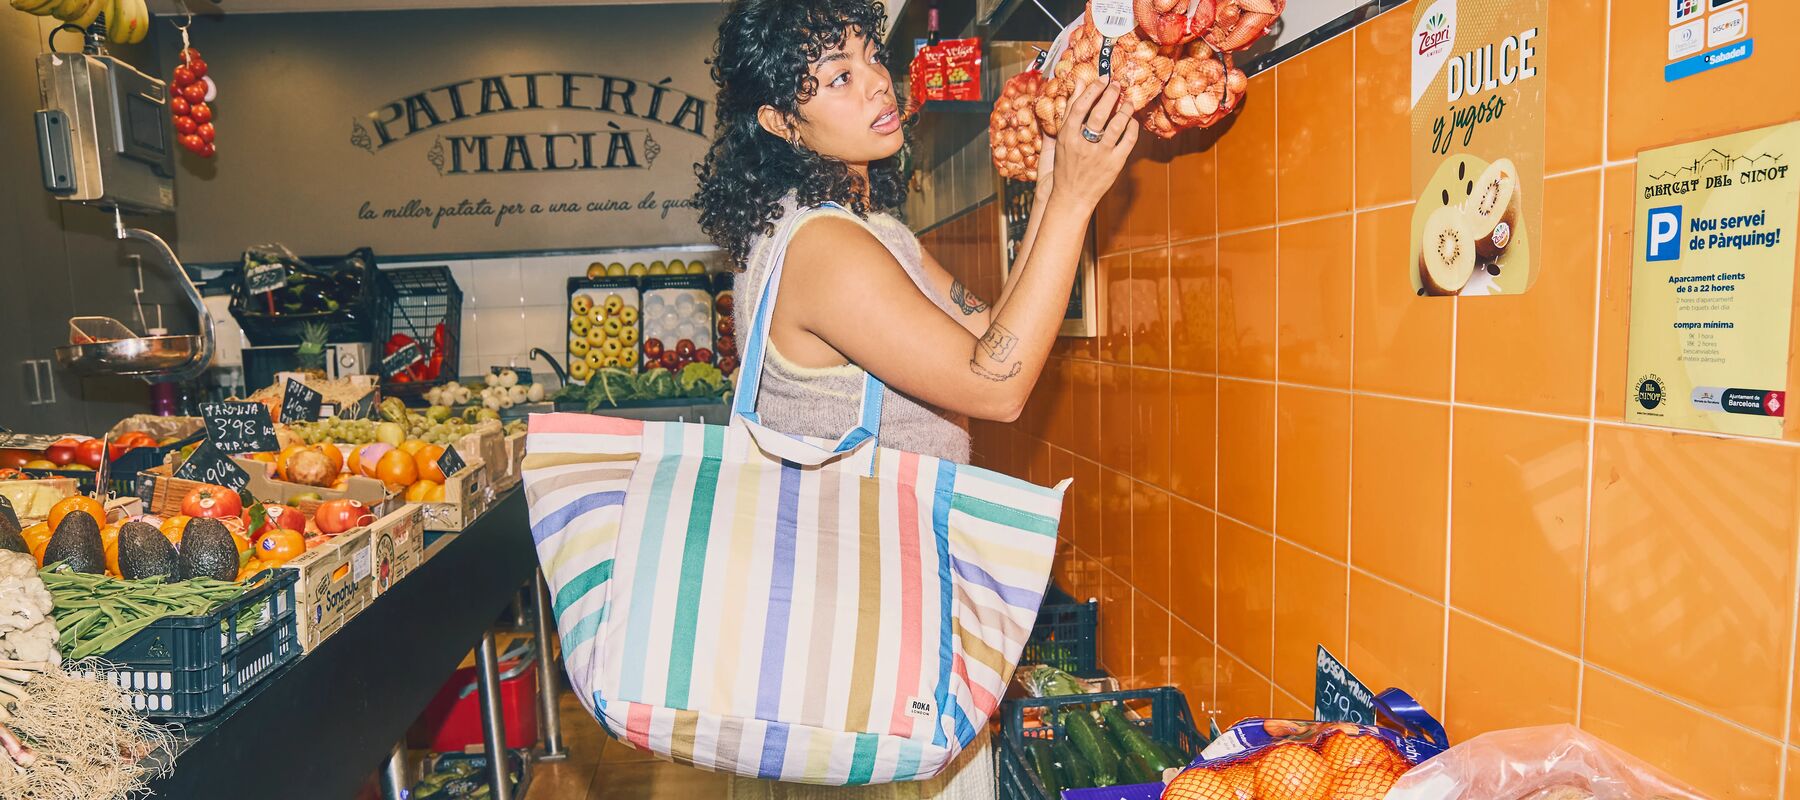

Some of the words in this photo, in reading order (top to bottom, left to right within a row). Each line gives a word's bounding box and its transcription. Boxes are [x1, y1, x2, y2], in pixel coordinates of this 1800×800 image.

[1712, 19, 1740, 34] DISCOVER
[1418, 25, 1450, 55] Zespri
[1447, 27, 1538, 102] DULCE
[1709, 45, 1746, 65] Sabadell
[370, 73, 710, 149] PATATERÍA
[1432, 115, 1446, 154] y
[1441, 94, 1507, 155] jugoso
[446, 121, 643, 173] MACIÀ
[1644, 178, 1699, 200] MERCAT
[1705, 174, 1732, 189] DEL
[1740, 165, 1789, 185] NINOT
[358, 201, 377, 219] la
[382, 200, 433, 218] millor
[433, 198, 495, 229] patata
[495, 203, 526, 227] per
[530, 203, 543, 214] a
[549, 202, 580, 213] una
[587, 196, 630, 212] cuina
[638, 191, 657, 209] de
[1690, 218, 1717, 232] Nou
[1720, 209, 1765, 229] servei
[1650, 212, 1678, 257] P
[1689, 236, 1706, 251] de
[1708, 228, 1781, 250] Pàrquing!
[1668, 273, 1715, 284] Aparcament
[1717, 272, 1746, 281] clients
[1676, 285, 1686, 293] de
[1687, 285, 1692, 293] 8
[1700, 284, 1710, 292] 22
[1711, 283, 1735, 292] hores
[1673, 321, 1702, 330] compra
[1703, 320, 1734, 329] mínima
[1728, 400, 1760, 408] Barcelona
[214, 418, 256, 439] 3'98
[912, 700, 930, 711] ROKA
